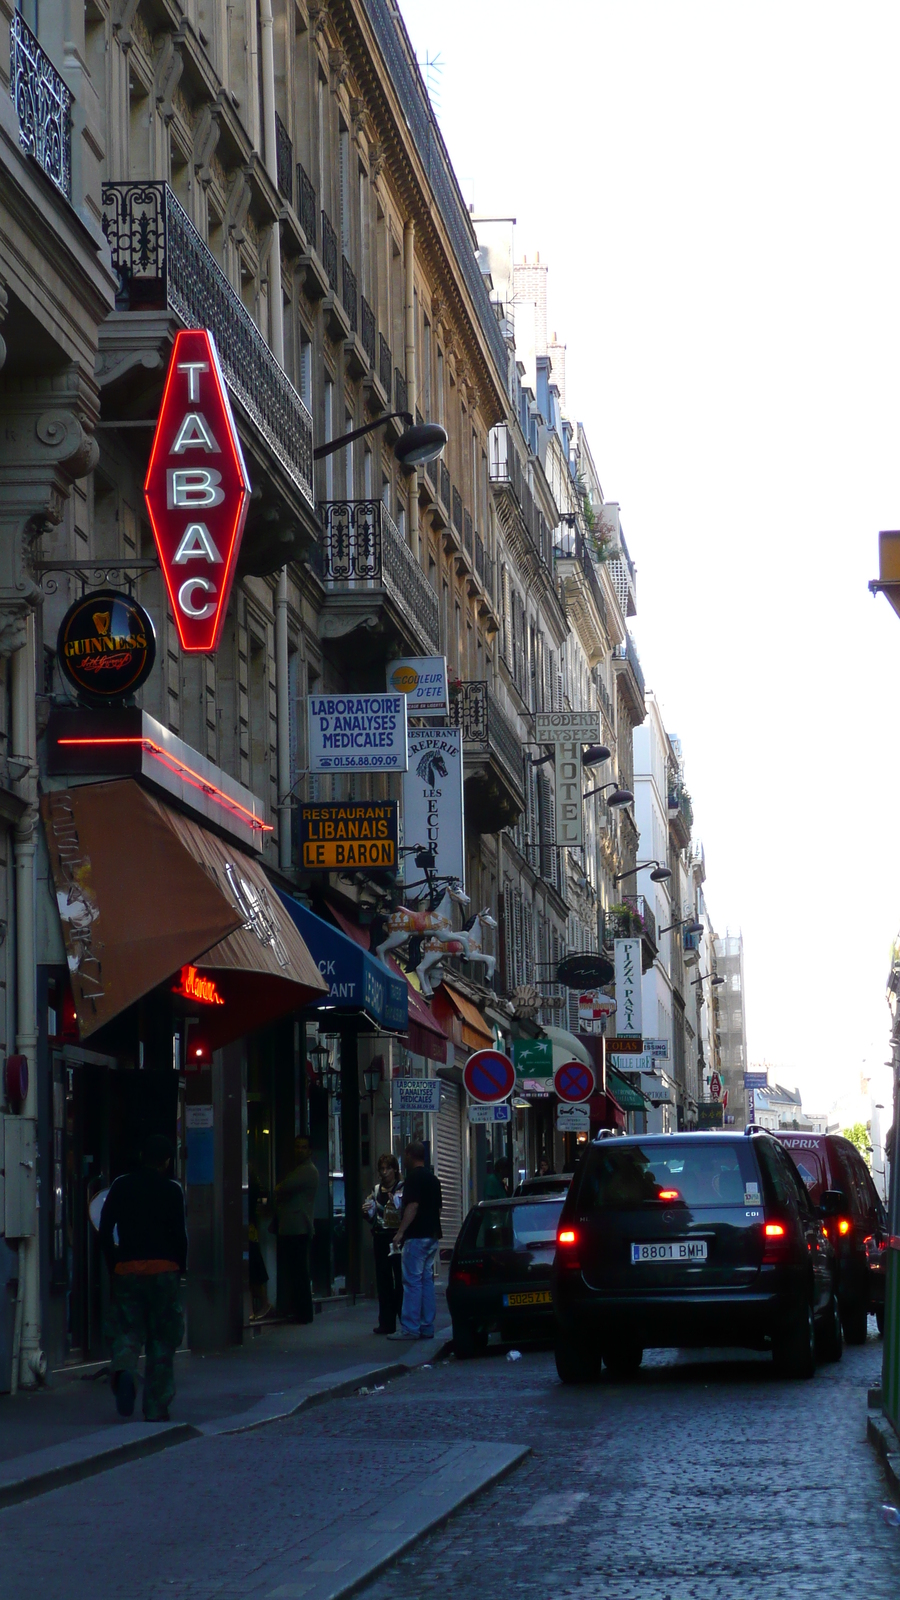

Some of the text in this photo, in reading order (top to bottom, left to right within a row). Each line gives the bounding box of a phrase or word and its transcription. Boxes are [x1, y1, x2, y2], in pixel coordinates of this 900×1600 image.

[166, 361, 225, 621] TABAC
[64, 633, 147, 657] GUINNESS
[401, 674, 442, 685] COULEUR
[416, 687, 442, 697] D'ETE
[311, 698, 401, 715] LABORATOIRE
[320, 715, 396, 732] D'ANALYSES
[537, 714, 599, 727] MODERN
[322, 732, 393, 749] MEDICALES
[538, 729, 598, 741] ELYSEES
[333, 756, 398, 767] 01.56.88.09.09
[422, 789, 442, 798] LES
[559, 742, 578, 841] HOTEL
[302, 807, 393, 820] RESTAURANT
[308, 820, 388, 839] LIBANAIS
[306, 843, 392, 864] LE BARON
[623, 944, 634, 1030] PIZZA PASTA
[612, 1056, 652, 1069] MILLE LIRE
[396, 1081, 437, 1089] LABORATOIRE
[400, 1096, 433, 1104] MEDICALES
[642, 1244, 703, 1258] 8801 BMH
[509, 1294, 533, 1304] 5025
[535, 1292, 545, 1302] ZT
